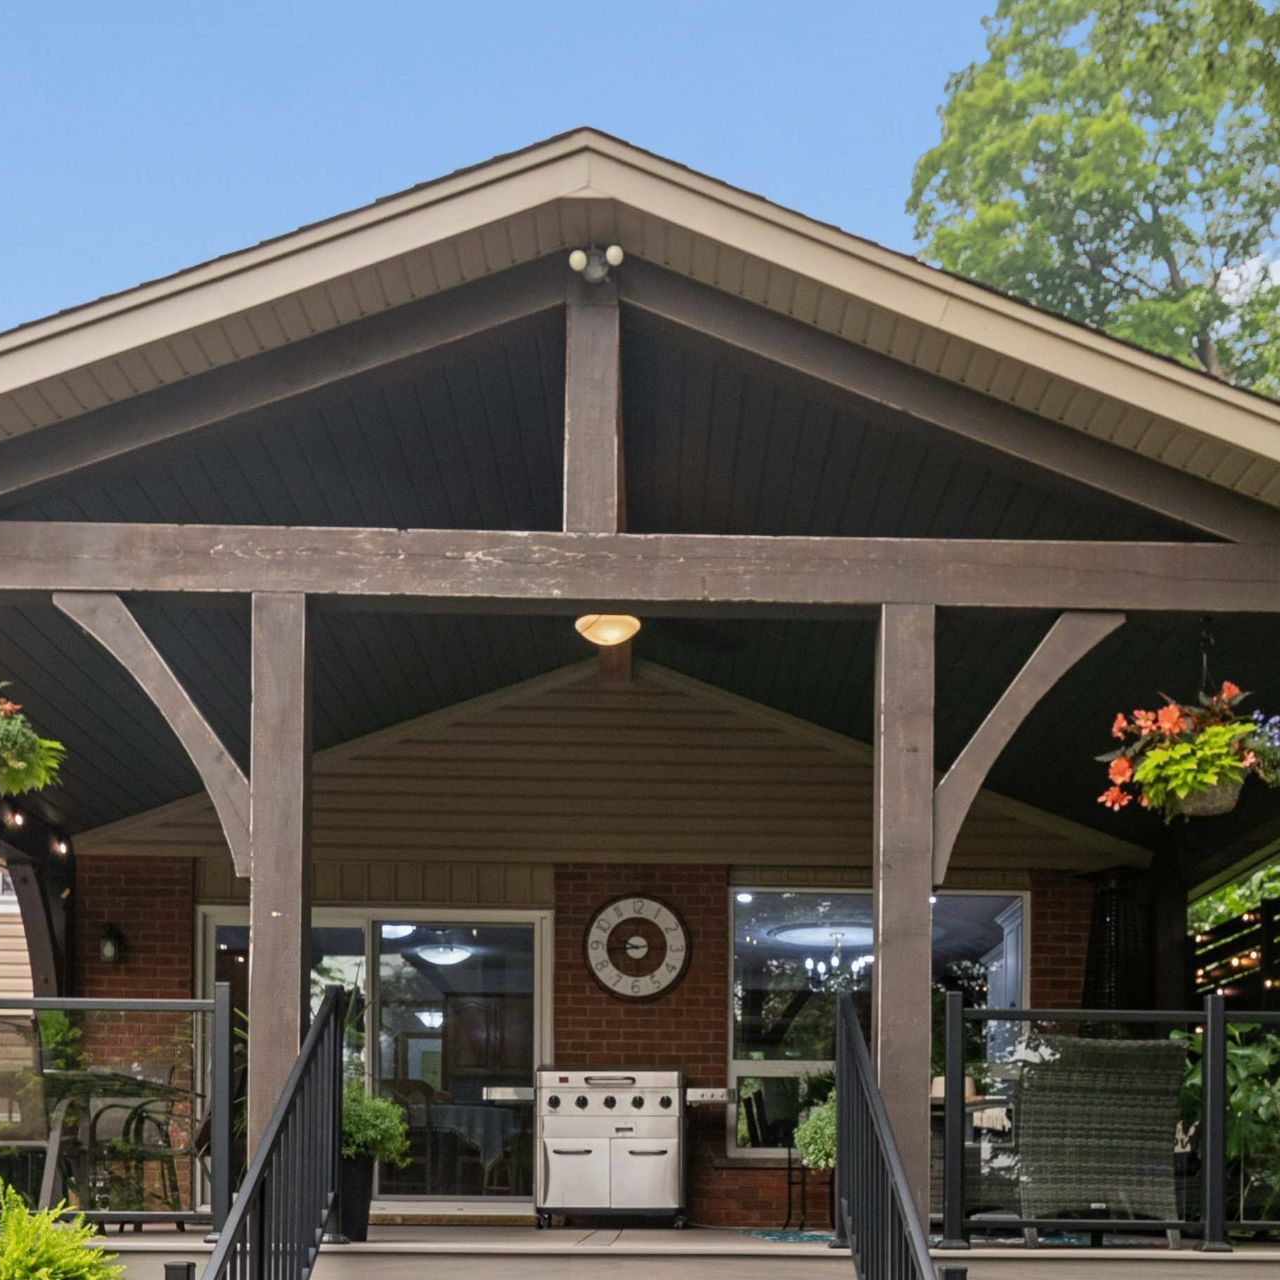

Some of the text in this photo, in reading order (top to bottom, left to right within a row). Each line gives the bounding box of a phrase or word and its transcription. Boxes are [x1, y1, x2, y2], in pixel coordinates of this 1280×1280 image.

[613, 905, 624, 918] 11
[632, 900, 645, 915] 12
[653, 907, 662, 919] 1
[596, 918, 611, 934] 10
[665, 922, 679, 935] 2
[590, 940, 605, 951] 9
[669, 944, 684, 953] 3
[595, 960, 609, 972] 8
[665, 962, 677, 974] 4
[612, 973, 623, 987] 7
[631, 978, 641, 994] 6
[650, 974, 661, 989] 5
